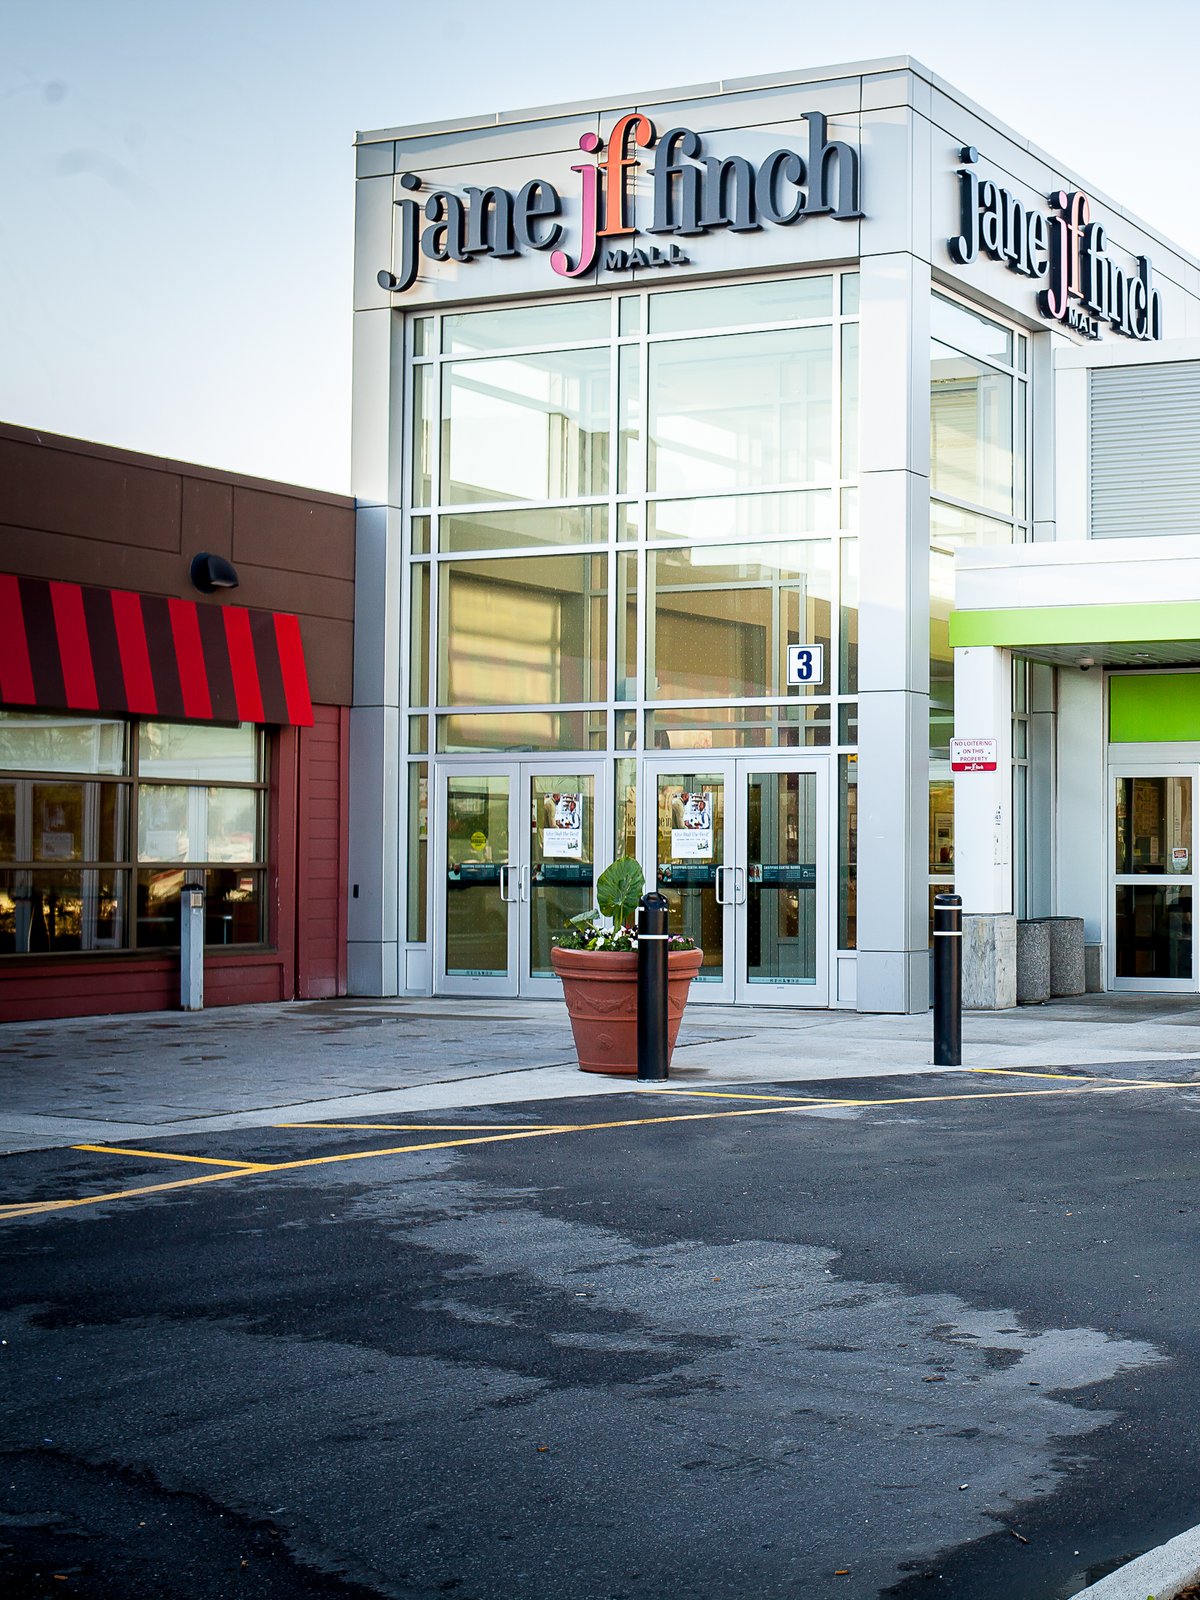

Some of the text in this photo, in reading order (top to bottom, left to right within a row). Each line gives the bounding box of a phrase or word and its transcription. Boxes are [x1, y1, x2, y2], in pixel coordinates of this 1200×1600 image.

[377, 110, 866, 293] jane jf finch
[947, 146, 1050, 279] jane
[1080, 221, 1163, 342] finch
[604, 243, 691, 271] MALL
[797, 650, 812, 680] 3
